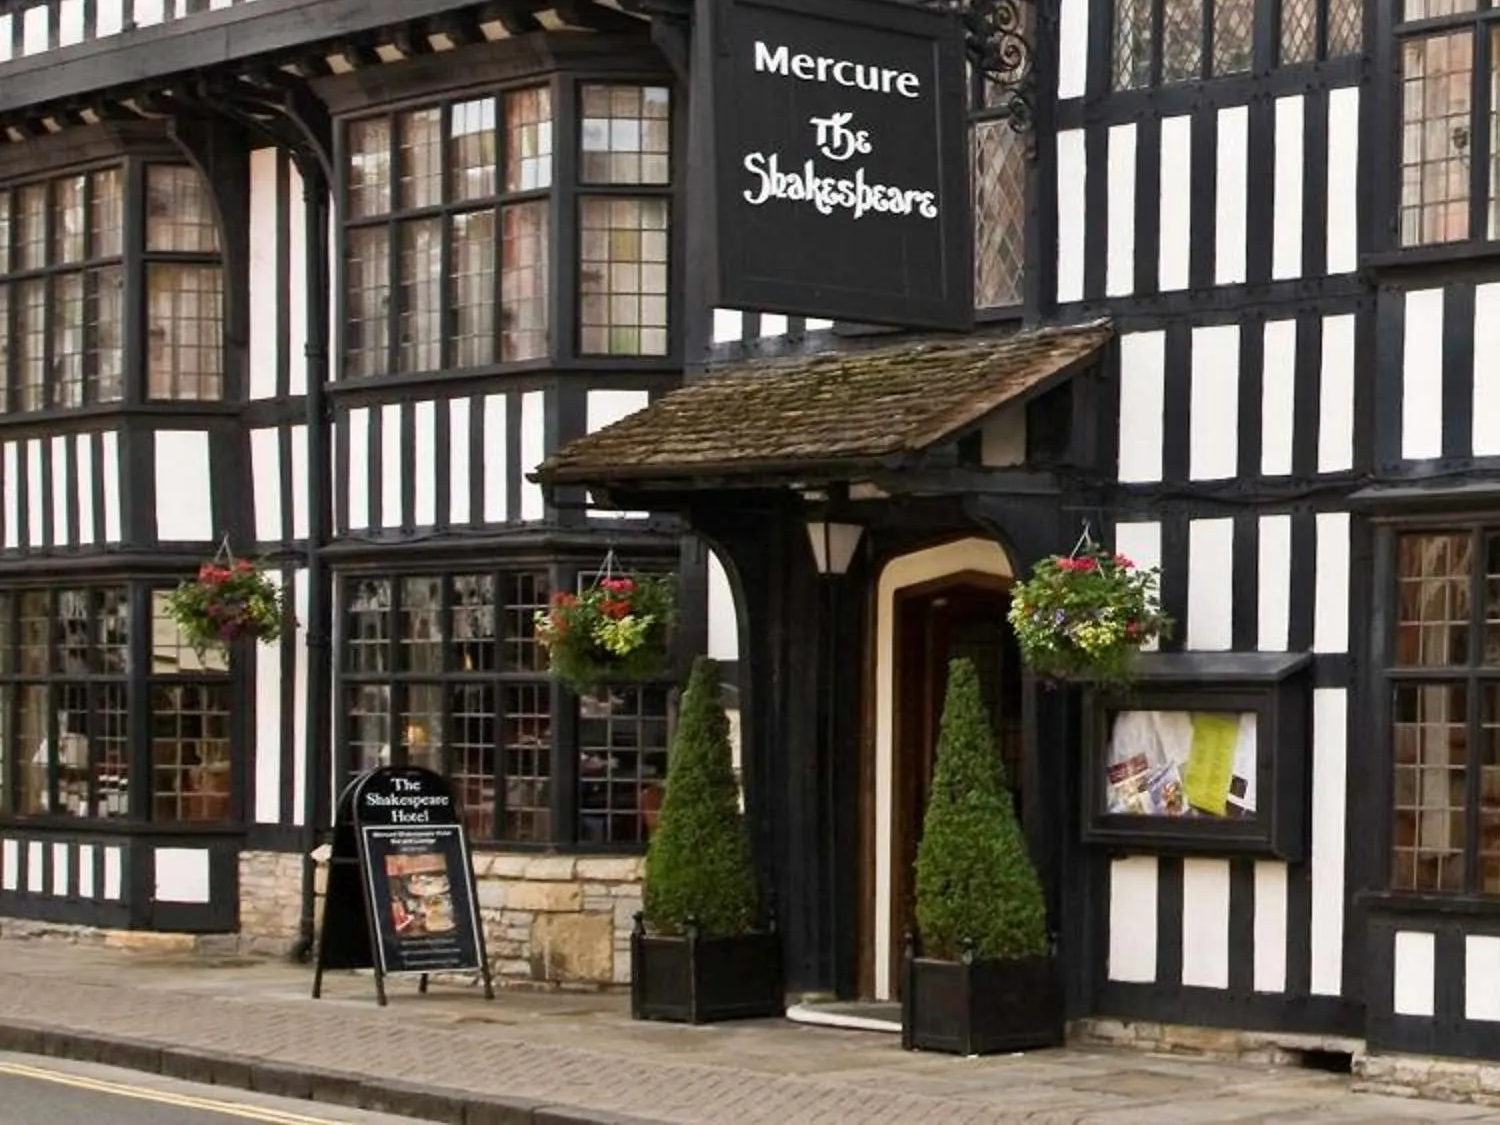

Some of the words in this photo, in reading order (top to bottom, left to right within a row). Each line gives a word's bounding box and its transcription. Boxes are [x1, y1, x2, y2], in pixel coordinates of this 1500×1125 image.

[755, 41, 920, 98] Mercure
[809, 112, 872, 160] The
[743, 152, 938, 220] Shakespeare
[390, 777, 421, 791] The
[366, 792, 449, 809] Shakespeare
[391, 808, 429, 822] Hotel
